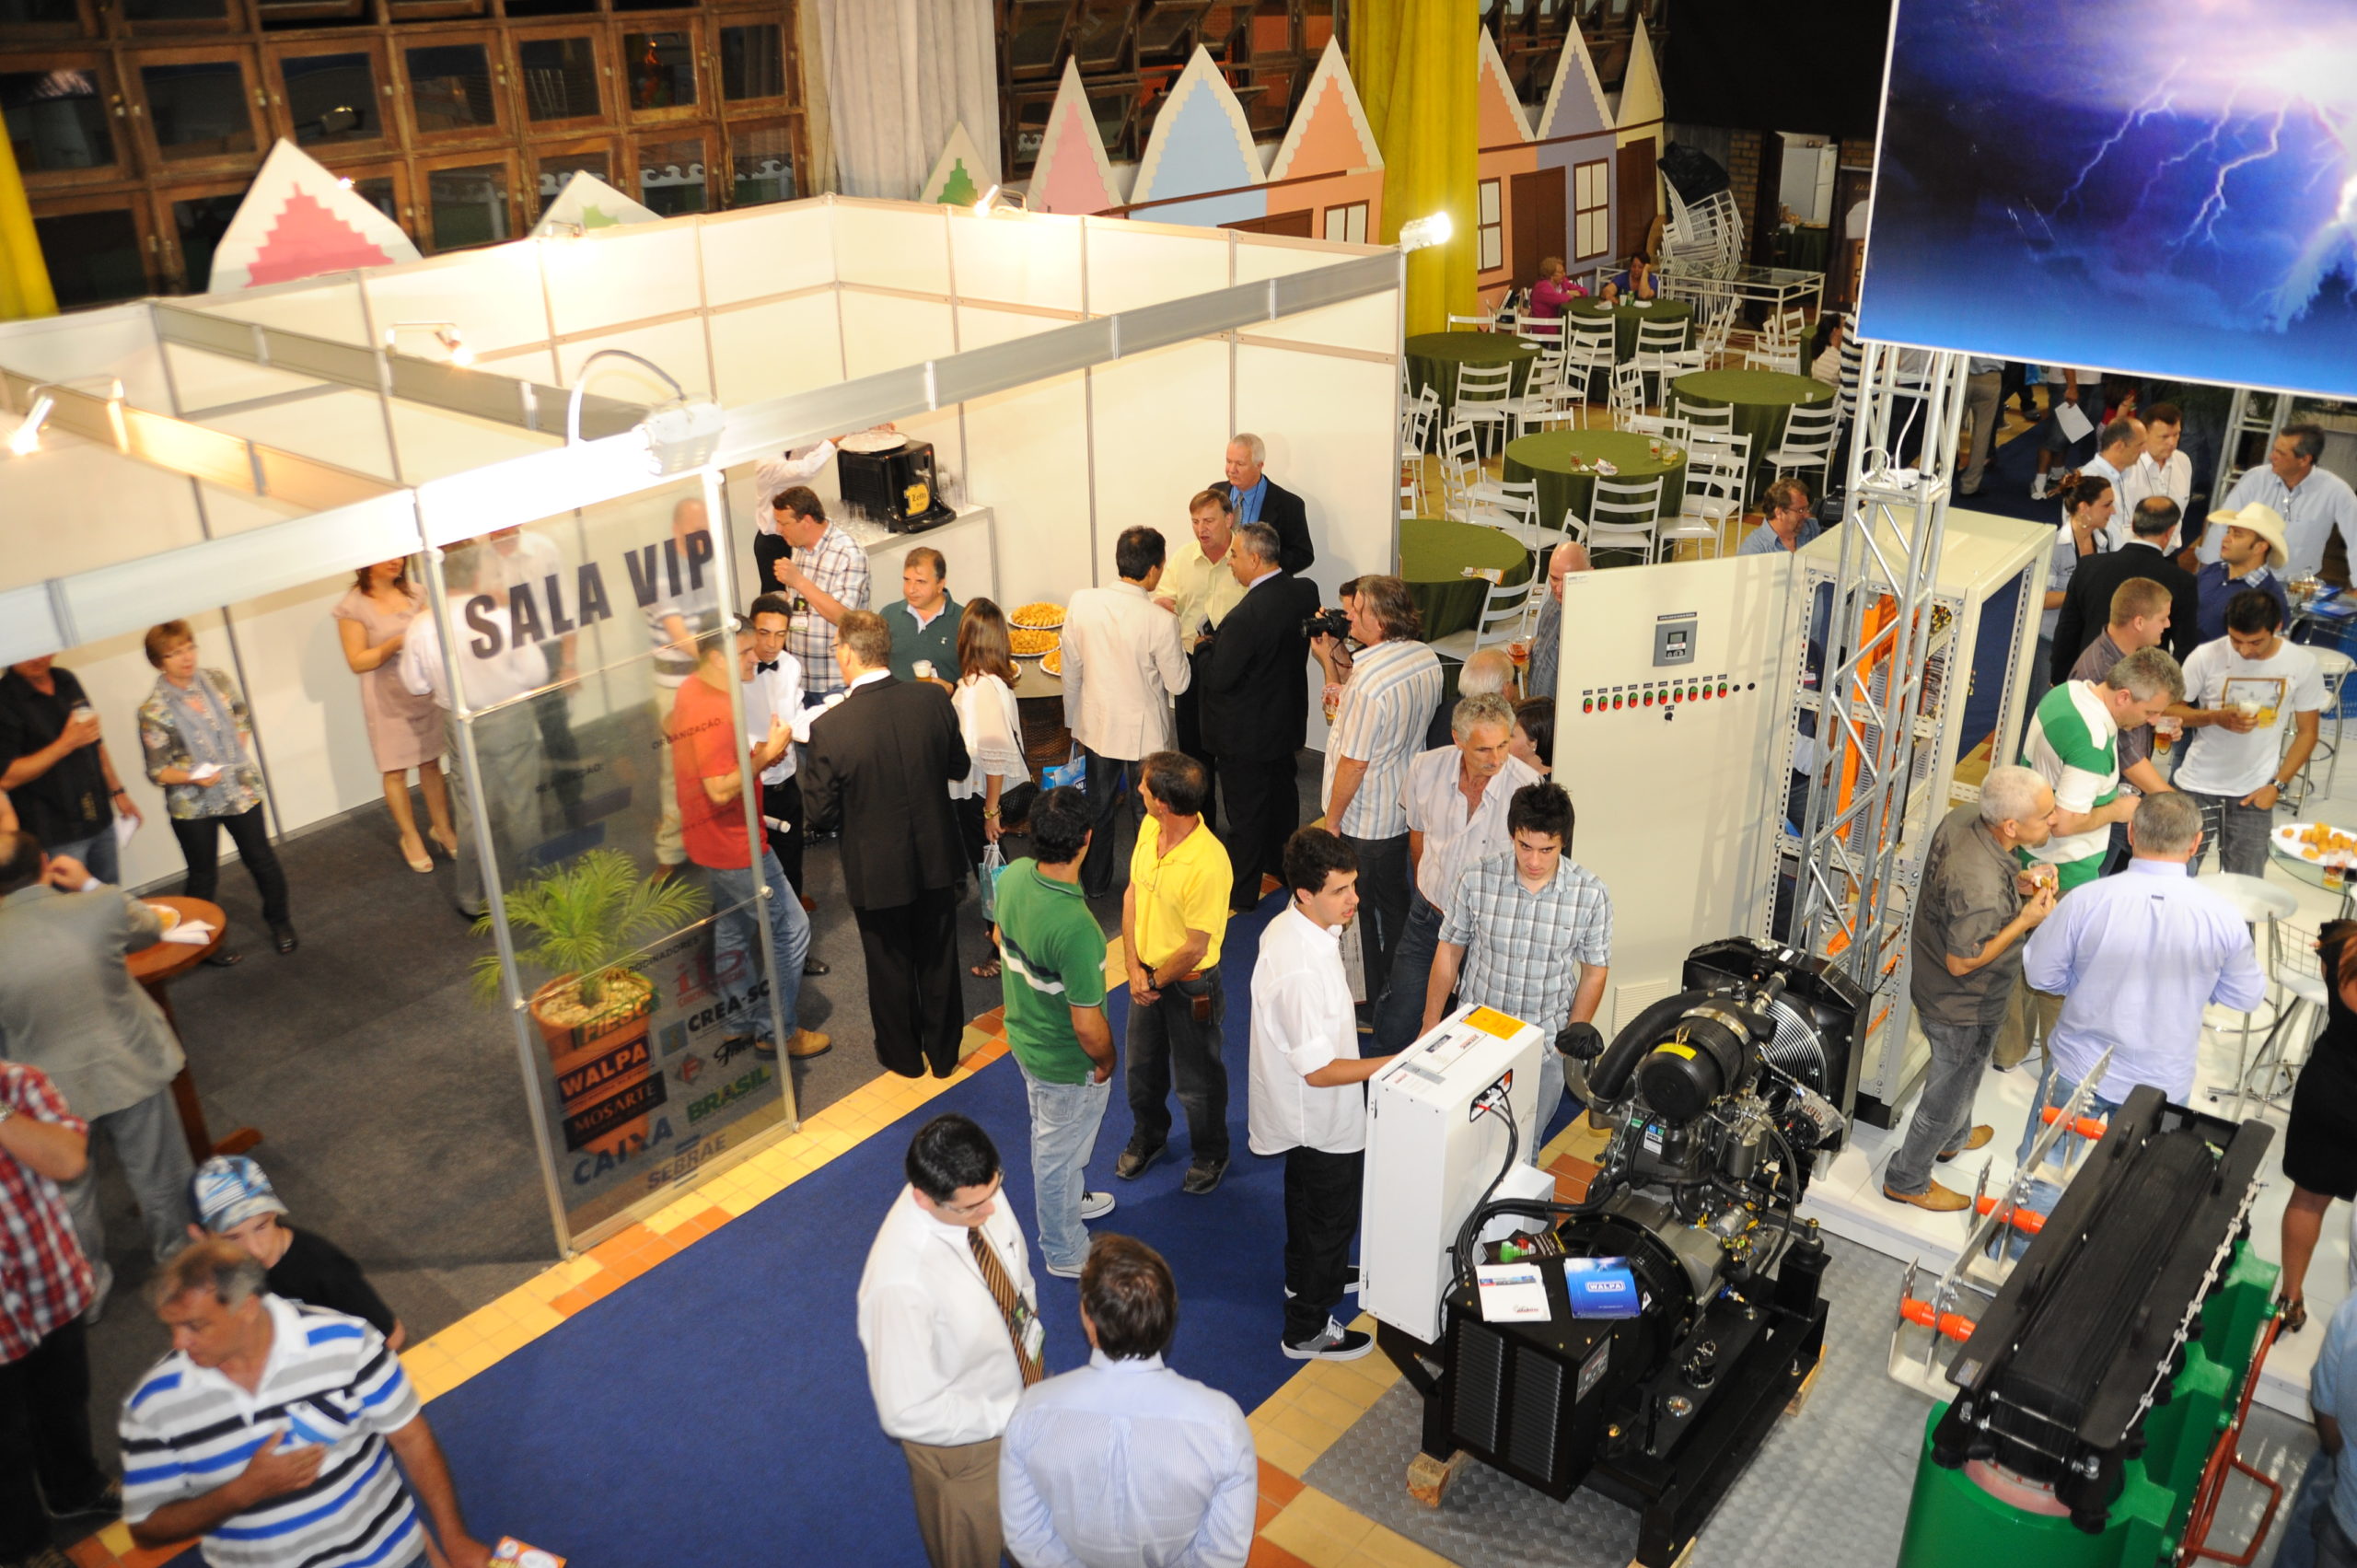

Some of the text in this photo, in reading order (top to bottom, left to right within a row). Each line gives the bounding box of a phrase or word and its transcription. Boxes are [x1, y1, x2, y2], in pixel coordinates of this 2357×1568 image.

[465, 529, 714, 660] SALA VIP
[687, 979, 771, 1032] CREA-SC
[561, 1042, 648, 1098] WALPA
[687, 1064, 772, 1123] BRASIL
[574, 1081, 656, 1132] MOSARTE
[573, 1116, 674, 1186] CAIXA
[647, 1133, 729, 1190] SEBRAE
[1588, 1281, 1624, 1292] WALPA
